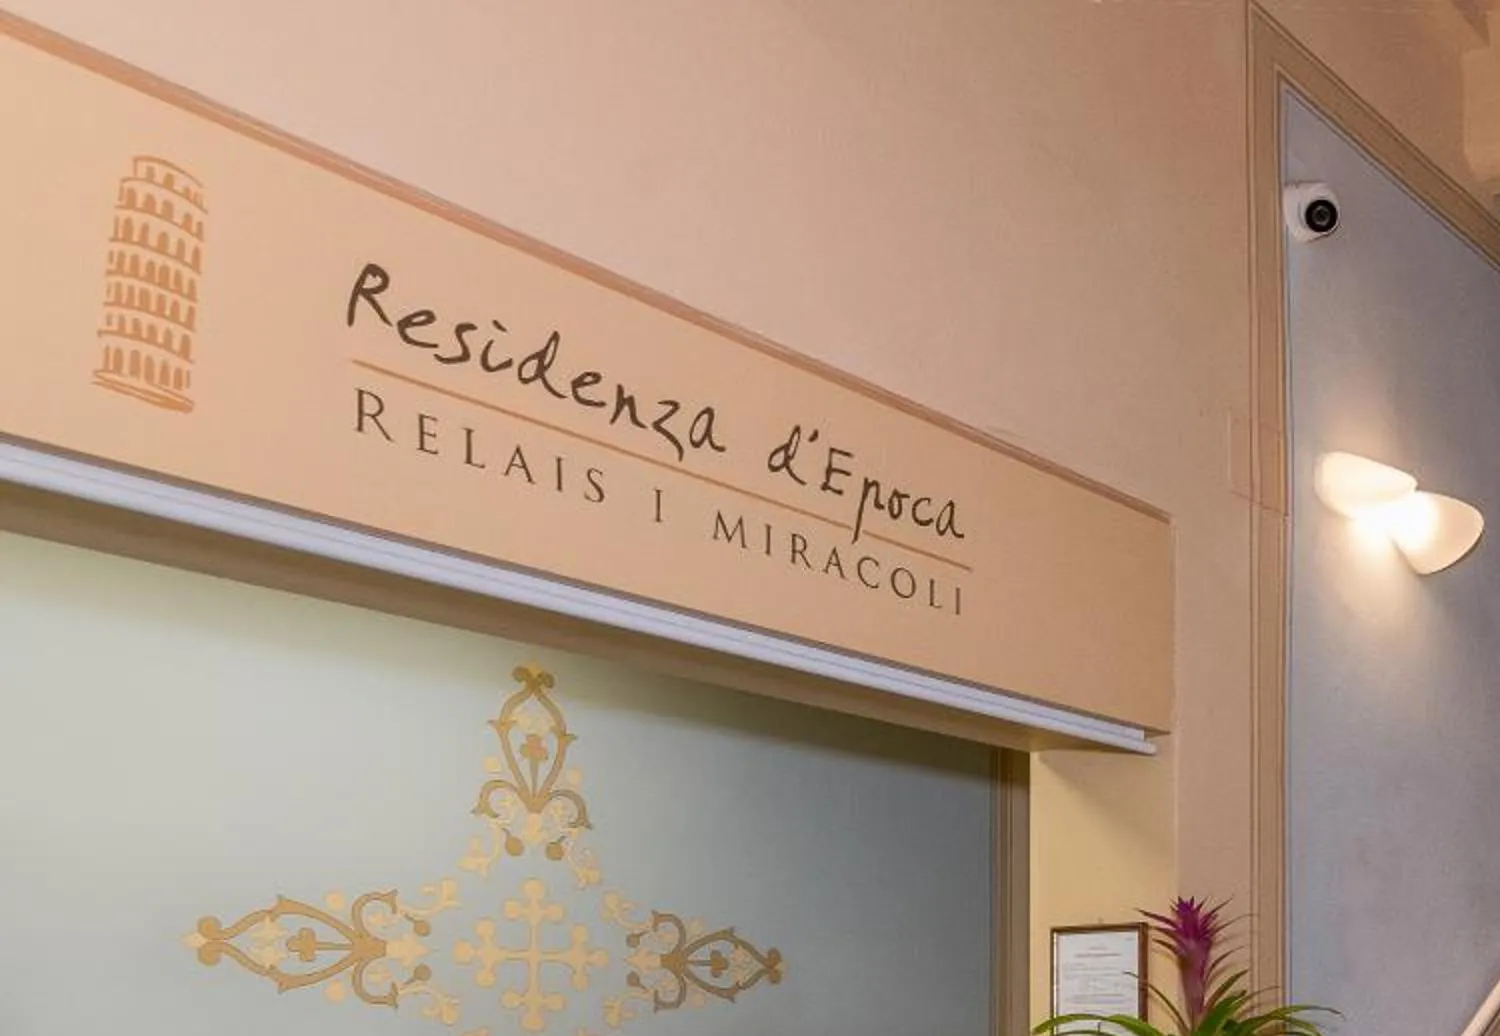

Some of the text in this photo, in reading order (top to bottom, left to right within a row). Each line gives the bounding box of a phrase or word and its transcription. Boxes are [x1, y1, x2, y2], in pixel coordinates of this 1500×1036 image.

[353, 386, 963, 617] RELAIS I MIRACOLI
[767, 426, 966, 545] d'Epoca
